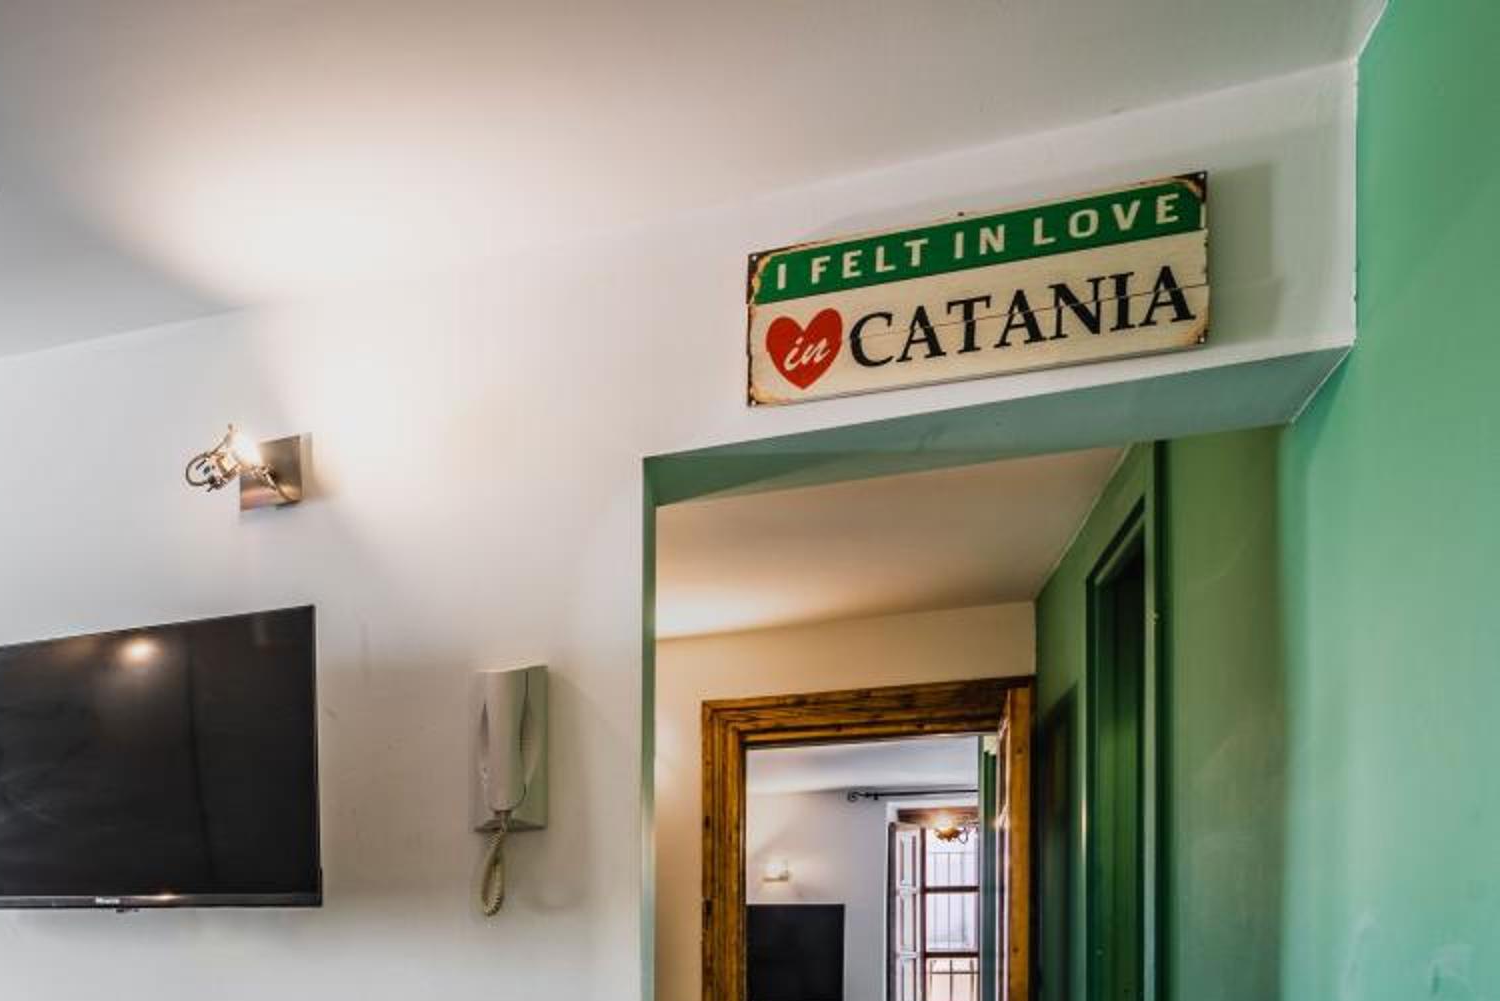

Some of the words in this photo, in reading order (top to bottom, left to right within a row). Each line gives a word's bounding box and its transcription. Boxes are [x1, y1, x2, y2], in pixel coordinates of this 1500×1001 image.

[776, 262, 788, 291] I
[810, 238, 930, 285] FELT
[953, 223, 1006, 260] IN
[1032, 192, 1181, 247] LOVE
[782, 335, 833, 372] in
[849, 265, 1197, 368] CATANIA
